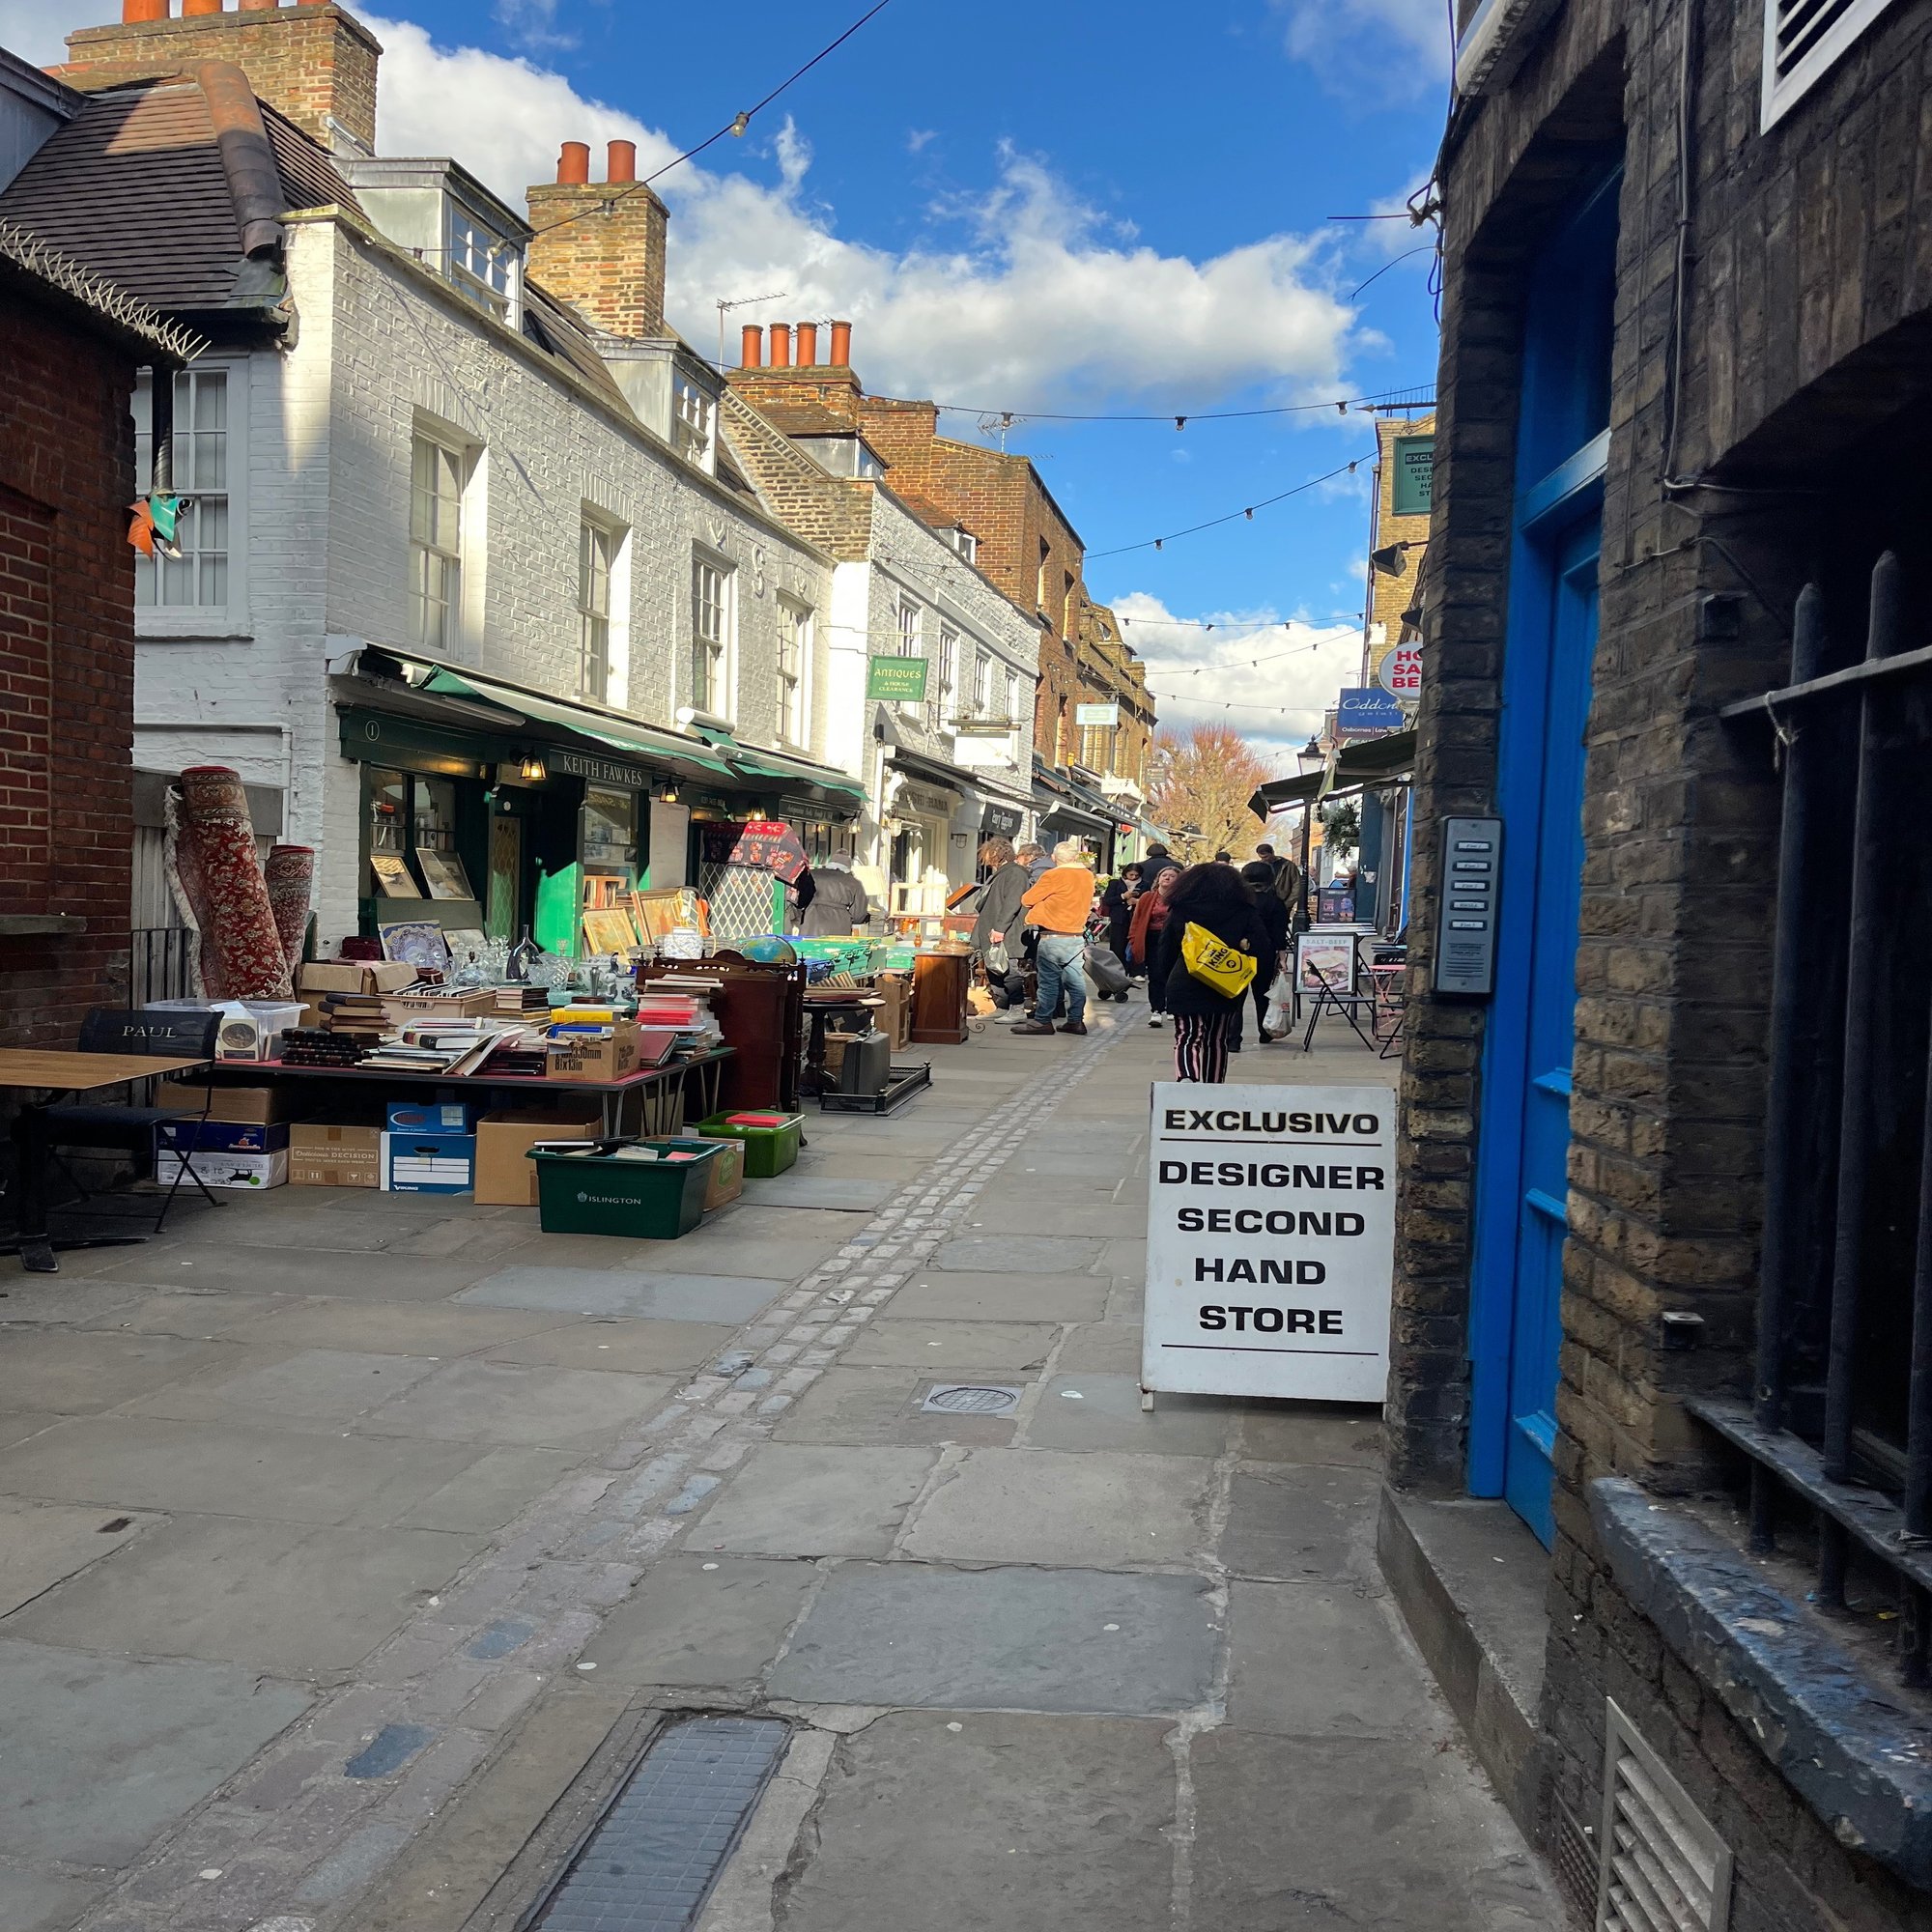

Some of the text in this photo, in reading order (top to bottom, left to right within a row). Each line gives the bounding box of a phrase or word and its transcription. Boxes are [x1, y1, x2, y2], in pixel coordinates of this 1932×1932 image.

[874, 668, 922, 679] ANTIQUES
[1393, 664, 1421, 675] SA
[1392, 677, 1419, 688] BE
[563, 754, 643, 786] KEITH FAWKES
[1208, 948, 1230, 967] KING
[122, 1025, 178, 1038] PAUL
[1165, 1110, 1379, 1134] EXCLUSIVO
[295, 1150, 329, 1158] Delicious
[1159, 1160, 1385, 1190] DESIGNER
[588, 1195, 641, 1205] ISLINGTON
[1178, 1208, 1365, 1236] SECOND
[1195, 1258, 1326, 1285] HAND
[1199, 1305, 1344, 1335] STORE
